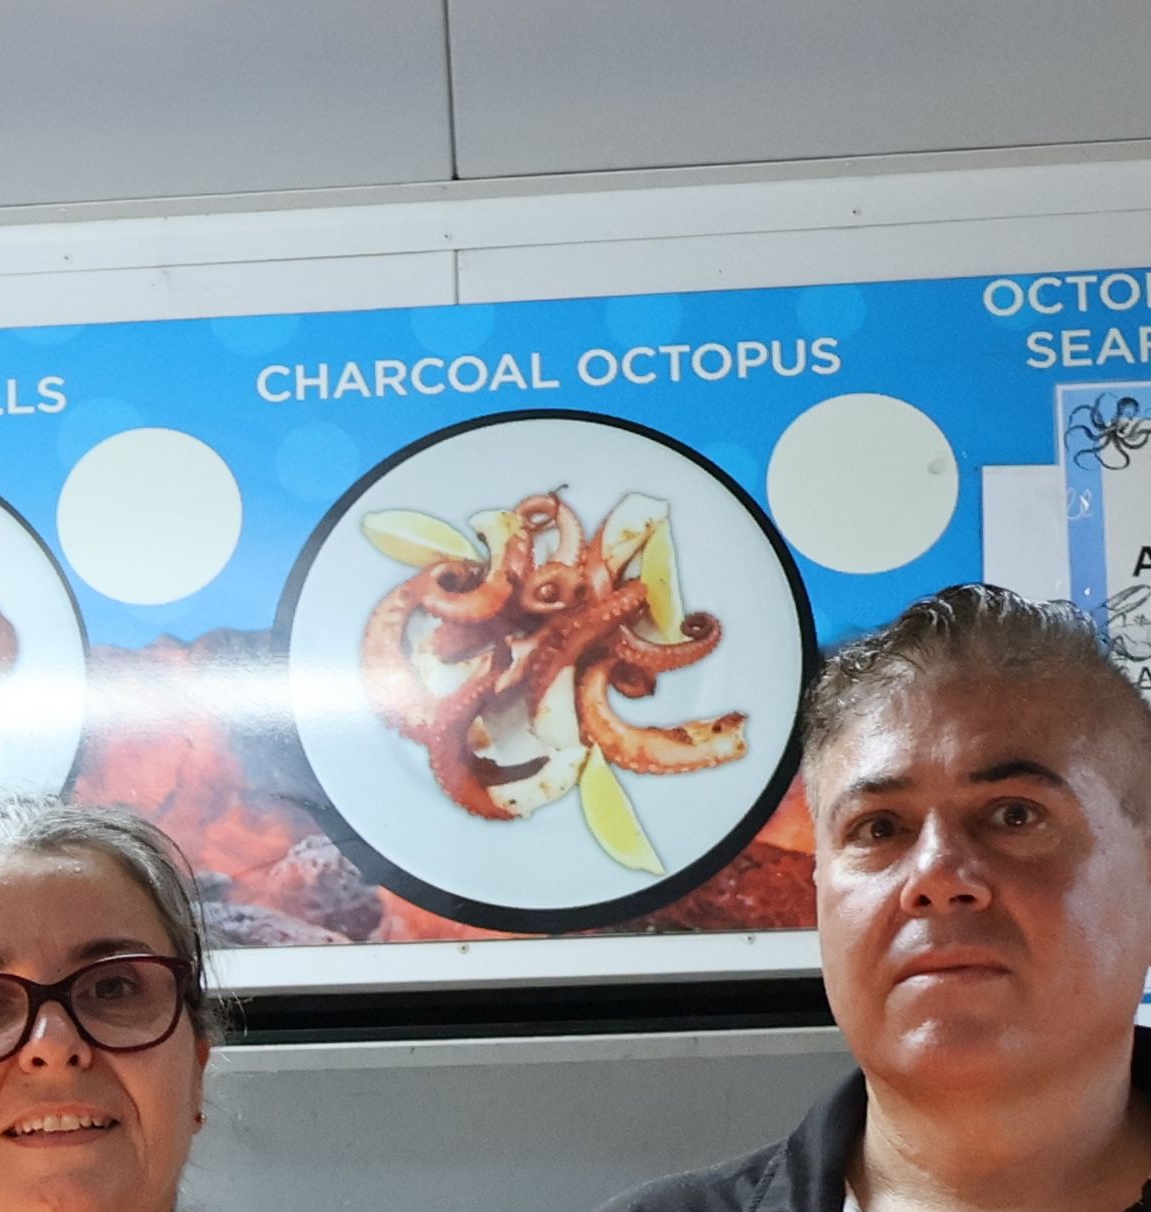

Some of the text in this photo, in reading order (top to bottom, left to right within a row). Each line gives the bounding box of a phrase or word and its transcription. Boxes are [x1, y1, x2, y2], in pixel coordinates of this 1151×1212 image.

[983, 273, 1151, 317] OCTO
[255, 337, 844, 403] CHARCOAL OCTOPUS
